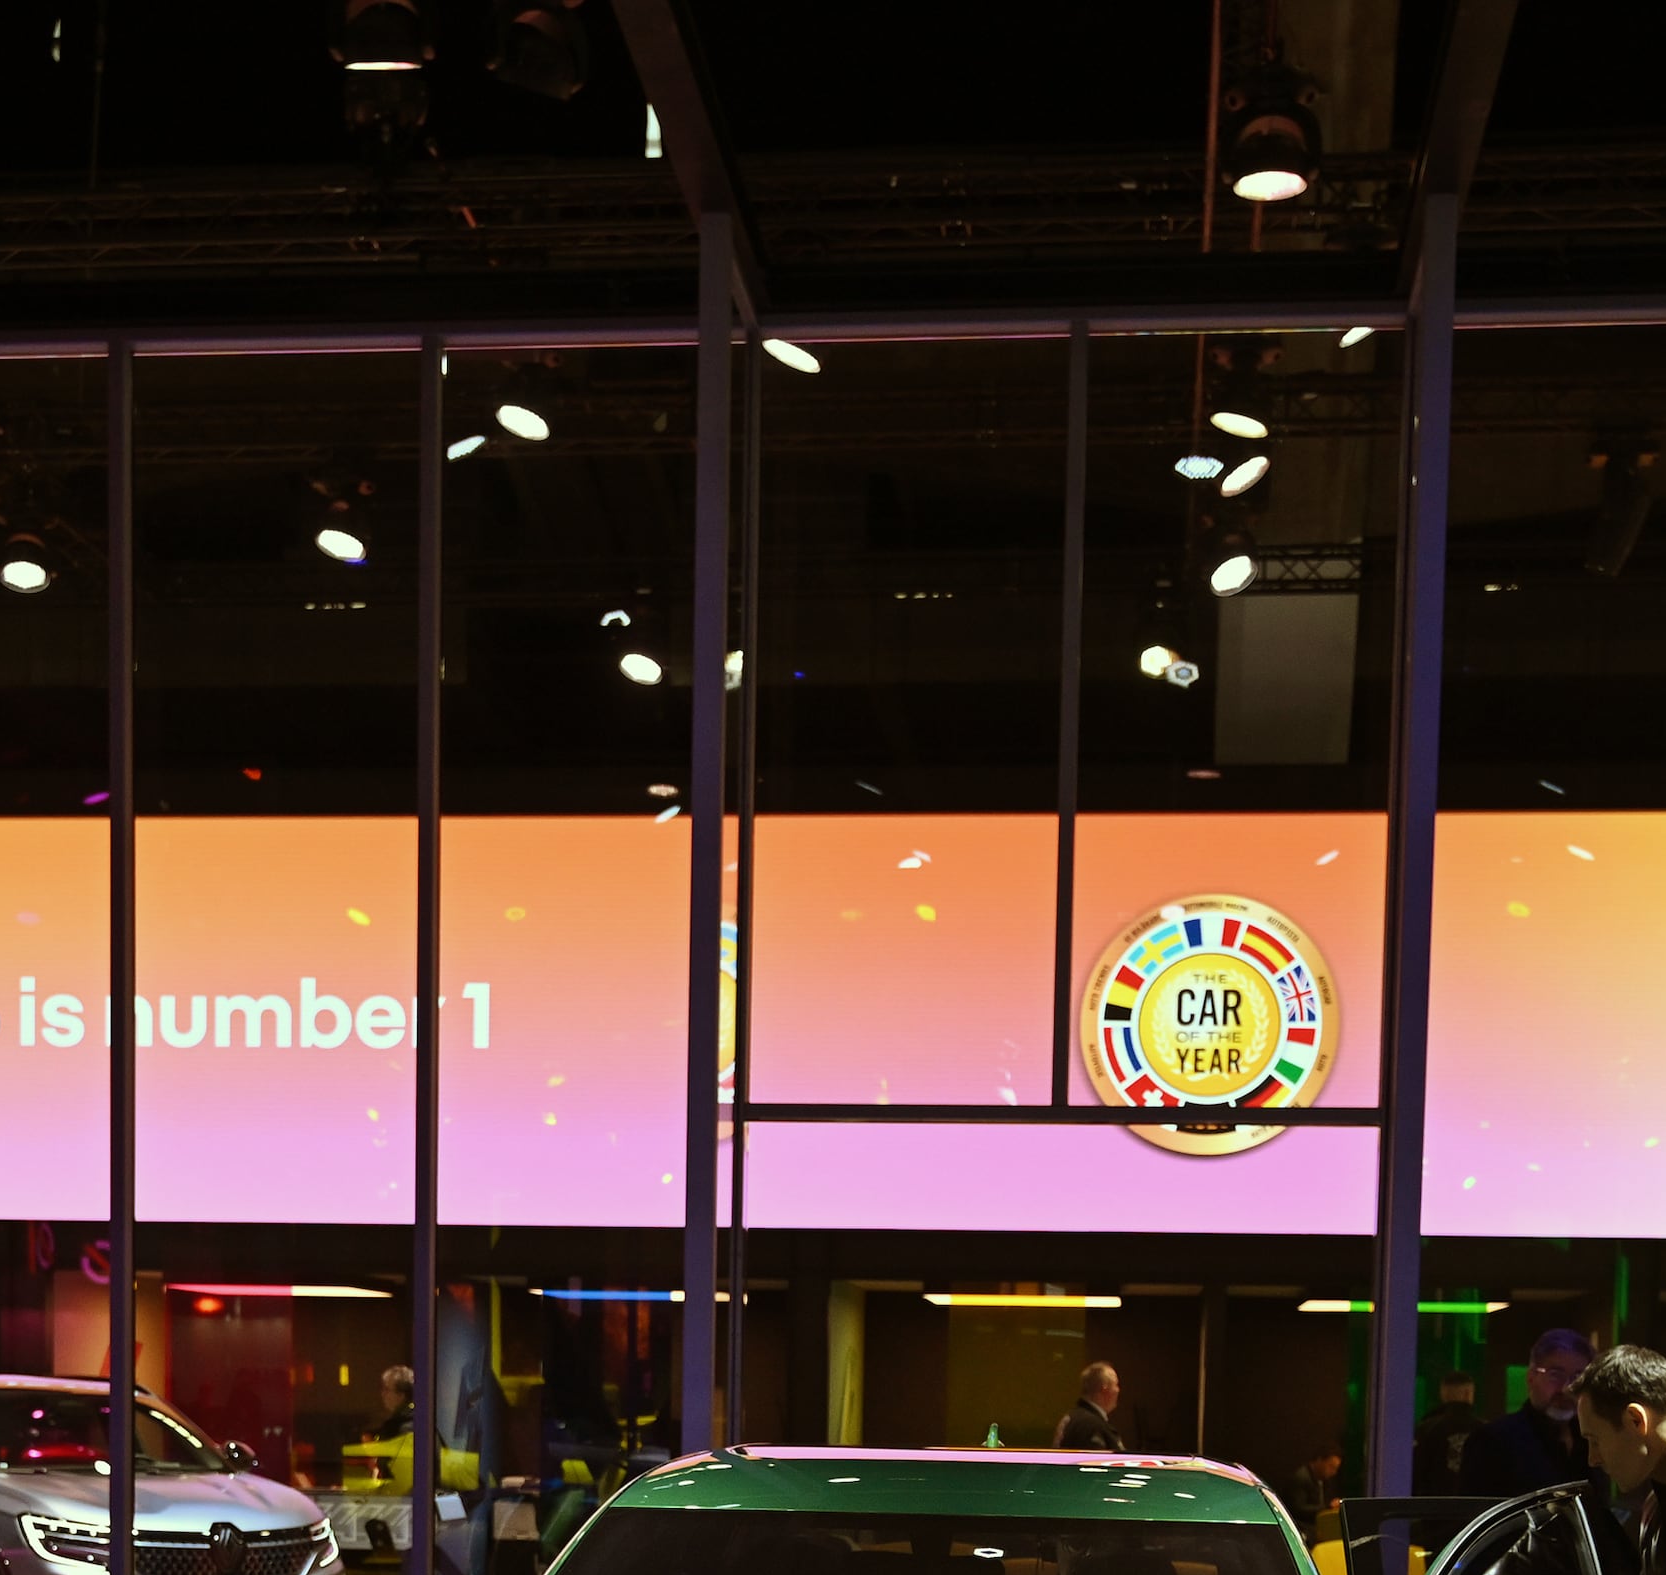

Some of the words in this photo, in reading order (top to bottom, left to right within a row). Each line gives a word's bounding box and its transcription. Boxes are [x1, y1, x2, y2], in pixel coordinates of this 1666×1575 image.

[1193, 974, 1227, 984] THE
[19, 976, 85, 1047] is
[462, 982, 490, 1049] 1
[1177, 989, 1241, 1026] CAR
[1176, 1031, 1200, 1043] OF
[1207, 1031, 1242, 1043] THE
[1176, 1048, 1241, 1073] YEAR
